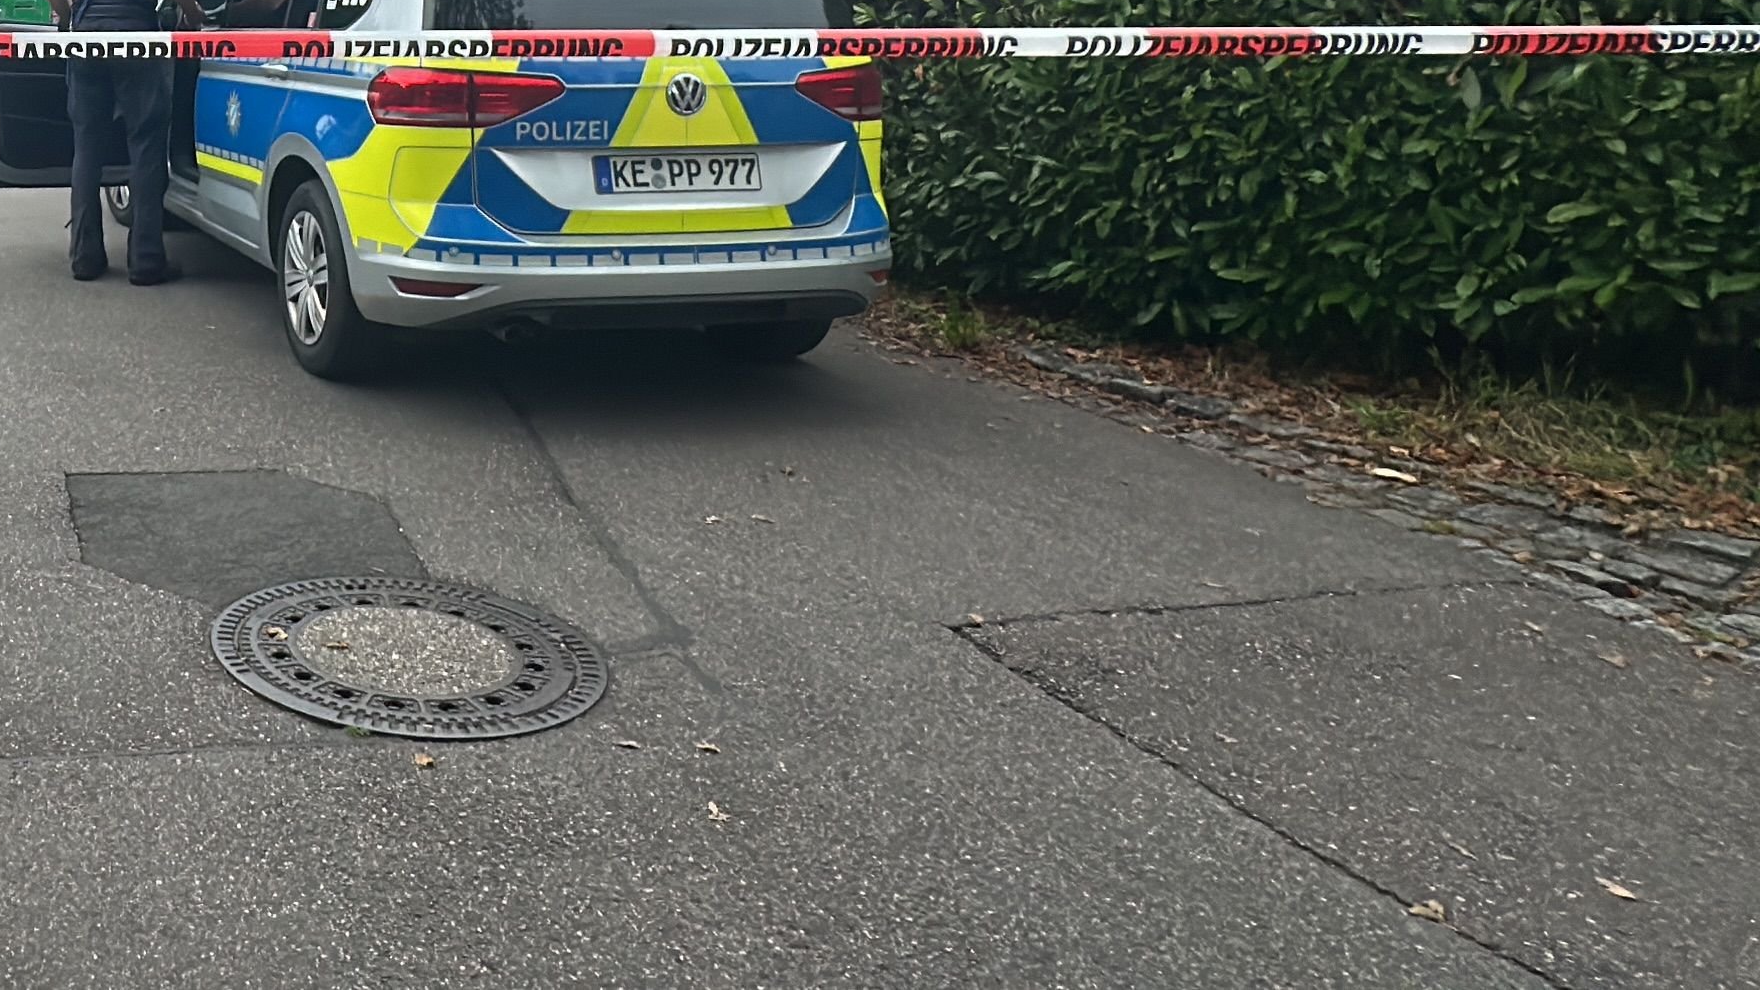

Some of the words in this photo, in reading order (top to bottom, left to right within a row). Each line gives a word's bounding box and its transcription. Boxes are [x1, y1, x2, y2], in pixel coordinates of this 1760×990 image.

[515, 120, 609, 141] POLIZEI
[613, 160, 650, 188] KE
[668, 158, 701, 186] PP
[708, 157, 756, 185] 977
